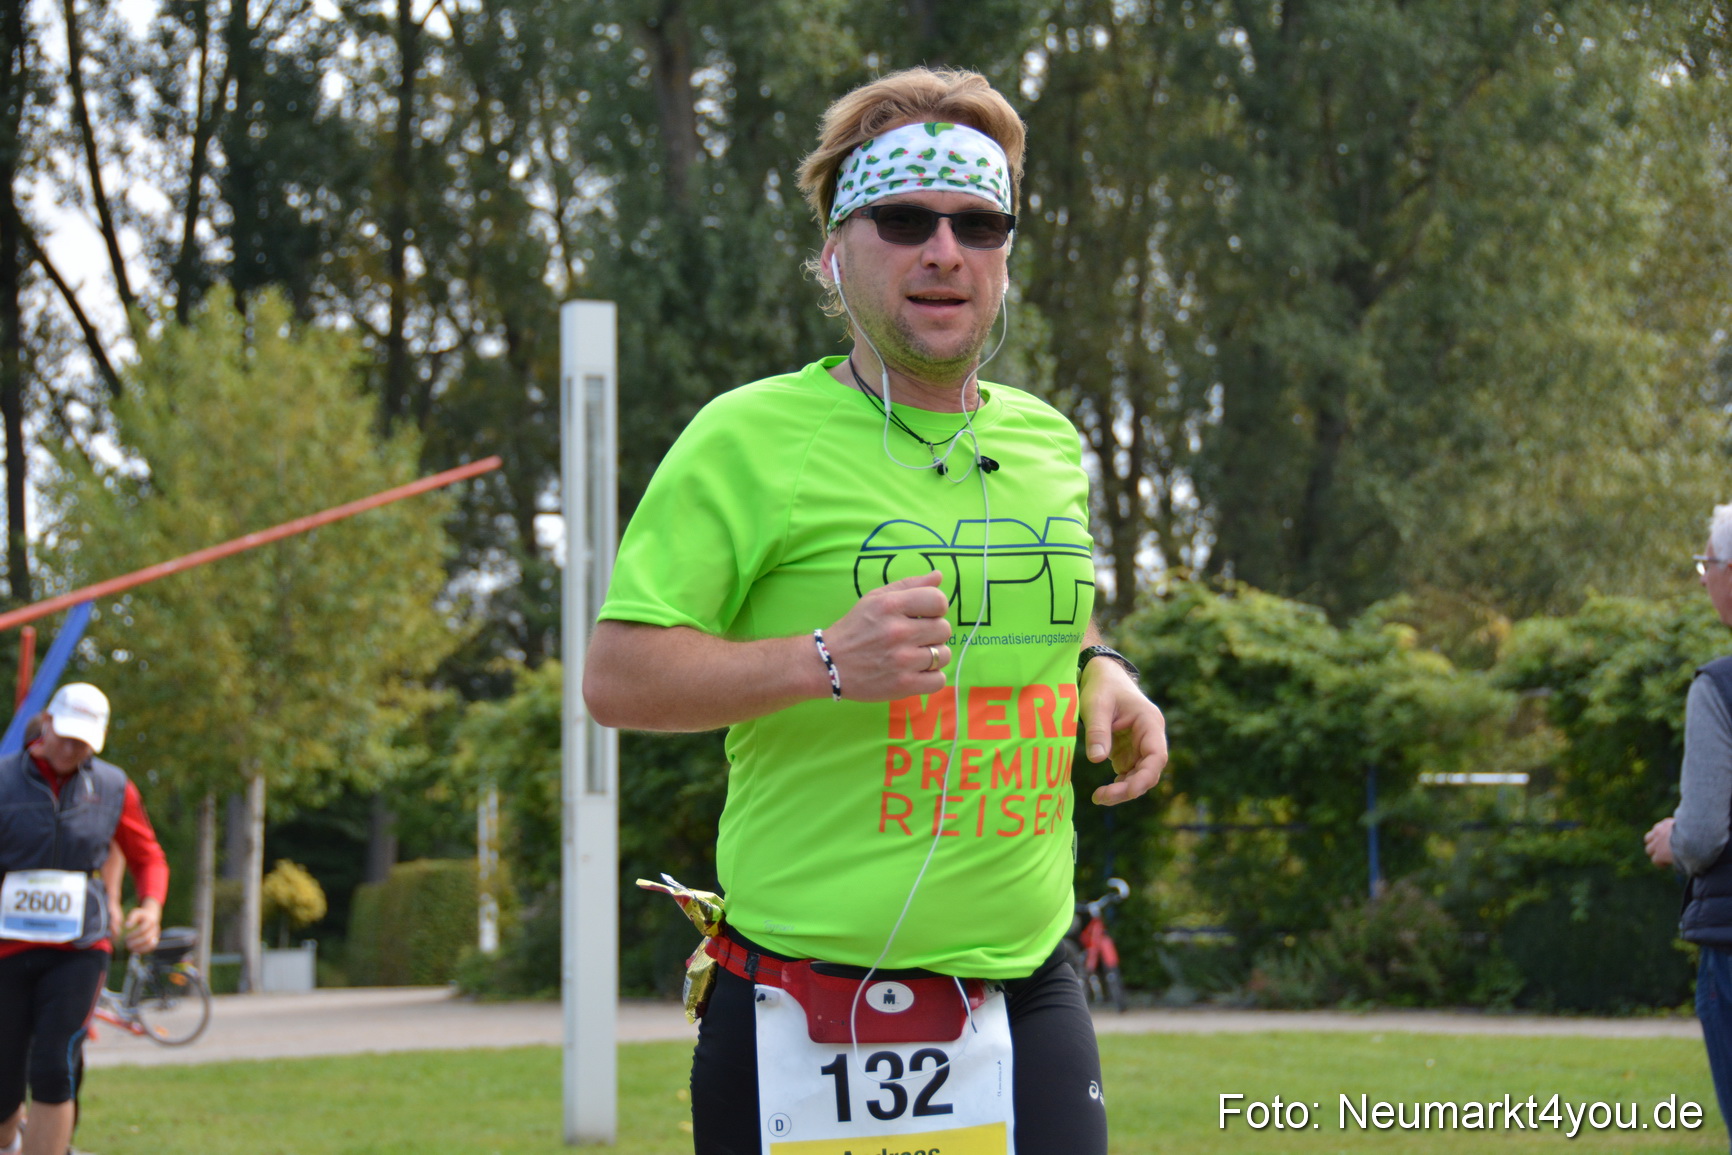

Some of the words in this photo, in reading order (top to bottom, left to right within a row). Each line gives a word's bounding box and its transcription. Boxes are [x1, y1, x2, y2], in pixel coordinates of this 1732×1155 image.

[887, 683, 1077, 740] MERZ
[14, 890, 72, 914] 2600
[821, 1048, 953, 1122] 132
[775, 1119, 784, 1132] D
